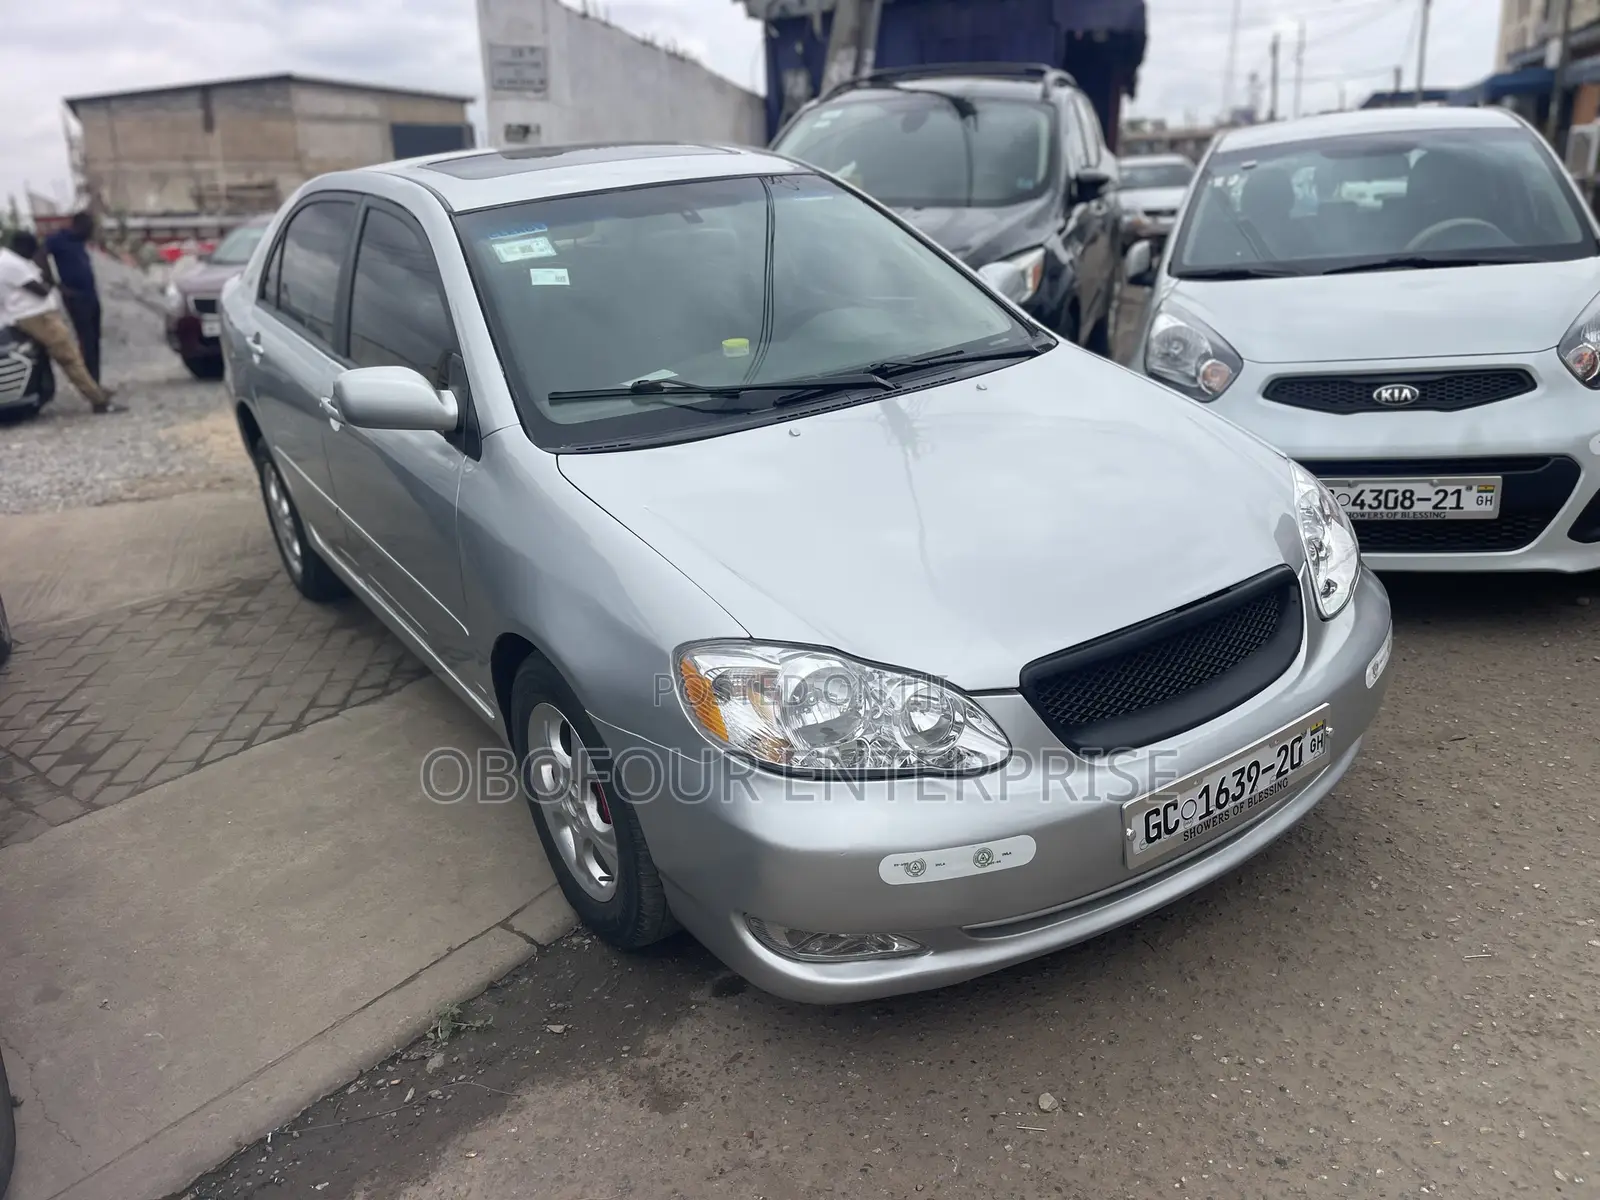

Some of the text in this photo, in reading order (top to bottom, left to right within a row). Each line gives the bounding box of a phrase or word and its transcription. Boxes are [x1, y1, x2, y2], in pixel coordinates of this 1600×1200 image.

[1380, 388, 1412, 402] KIA
[1475, 495, 1493, 507] GH
[1386, 511, 1399, 520] OF
[1401, 511, 1447, 520] BLESSING
[1309, 733, 1324, 754] GH
[1183, 777, 1289, 842] SHOWERS OF BLESSING
